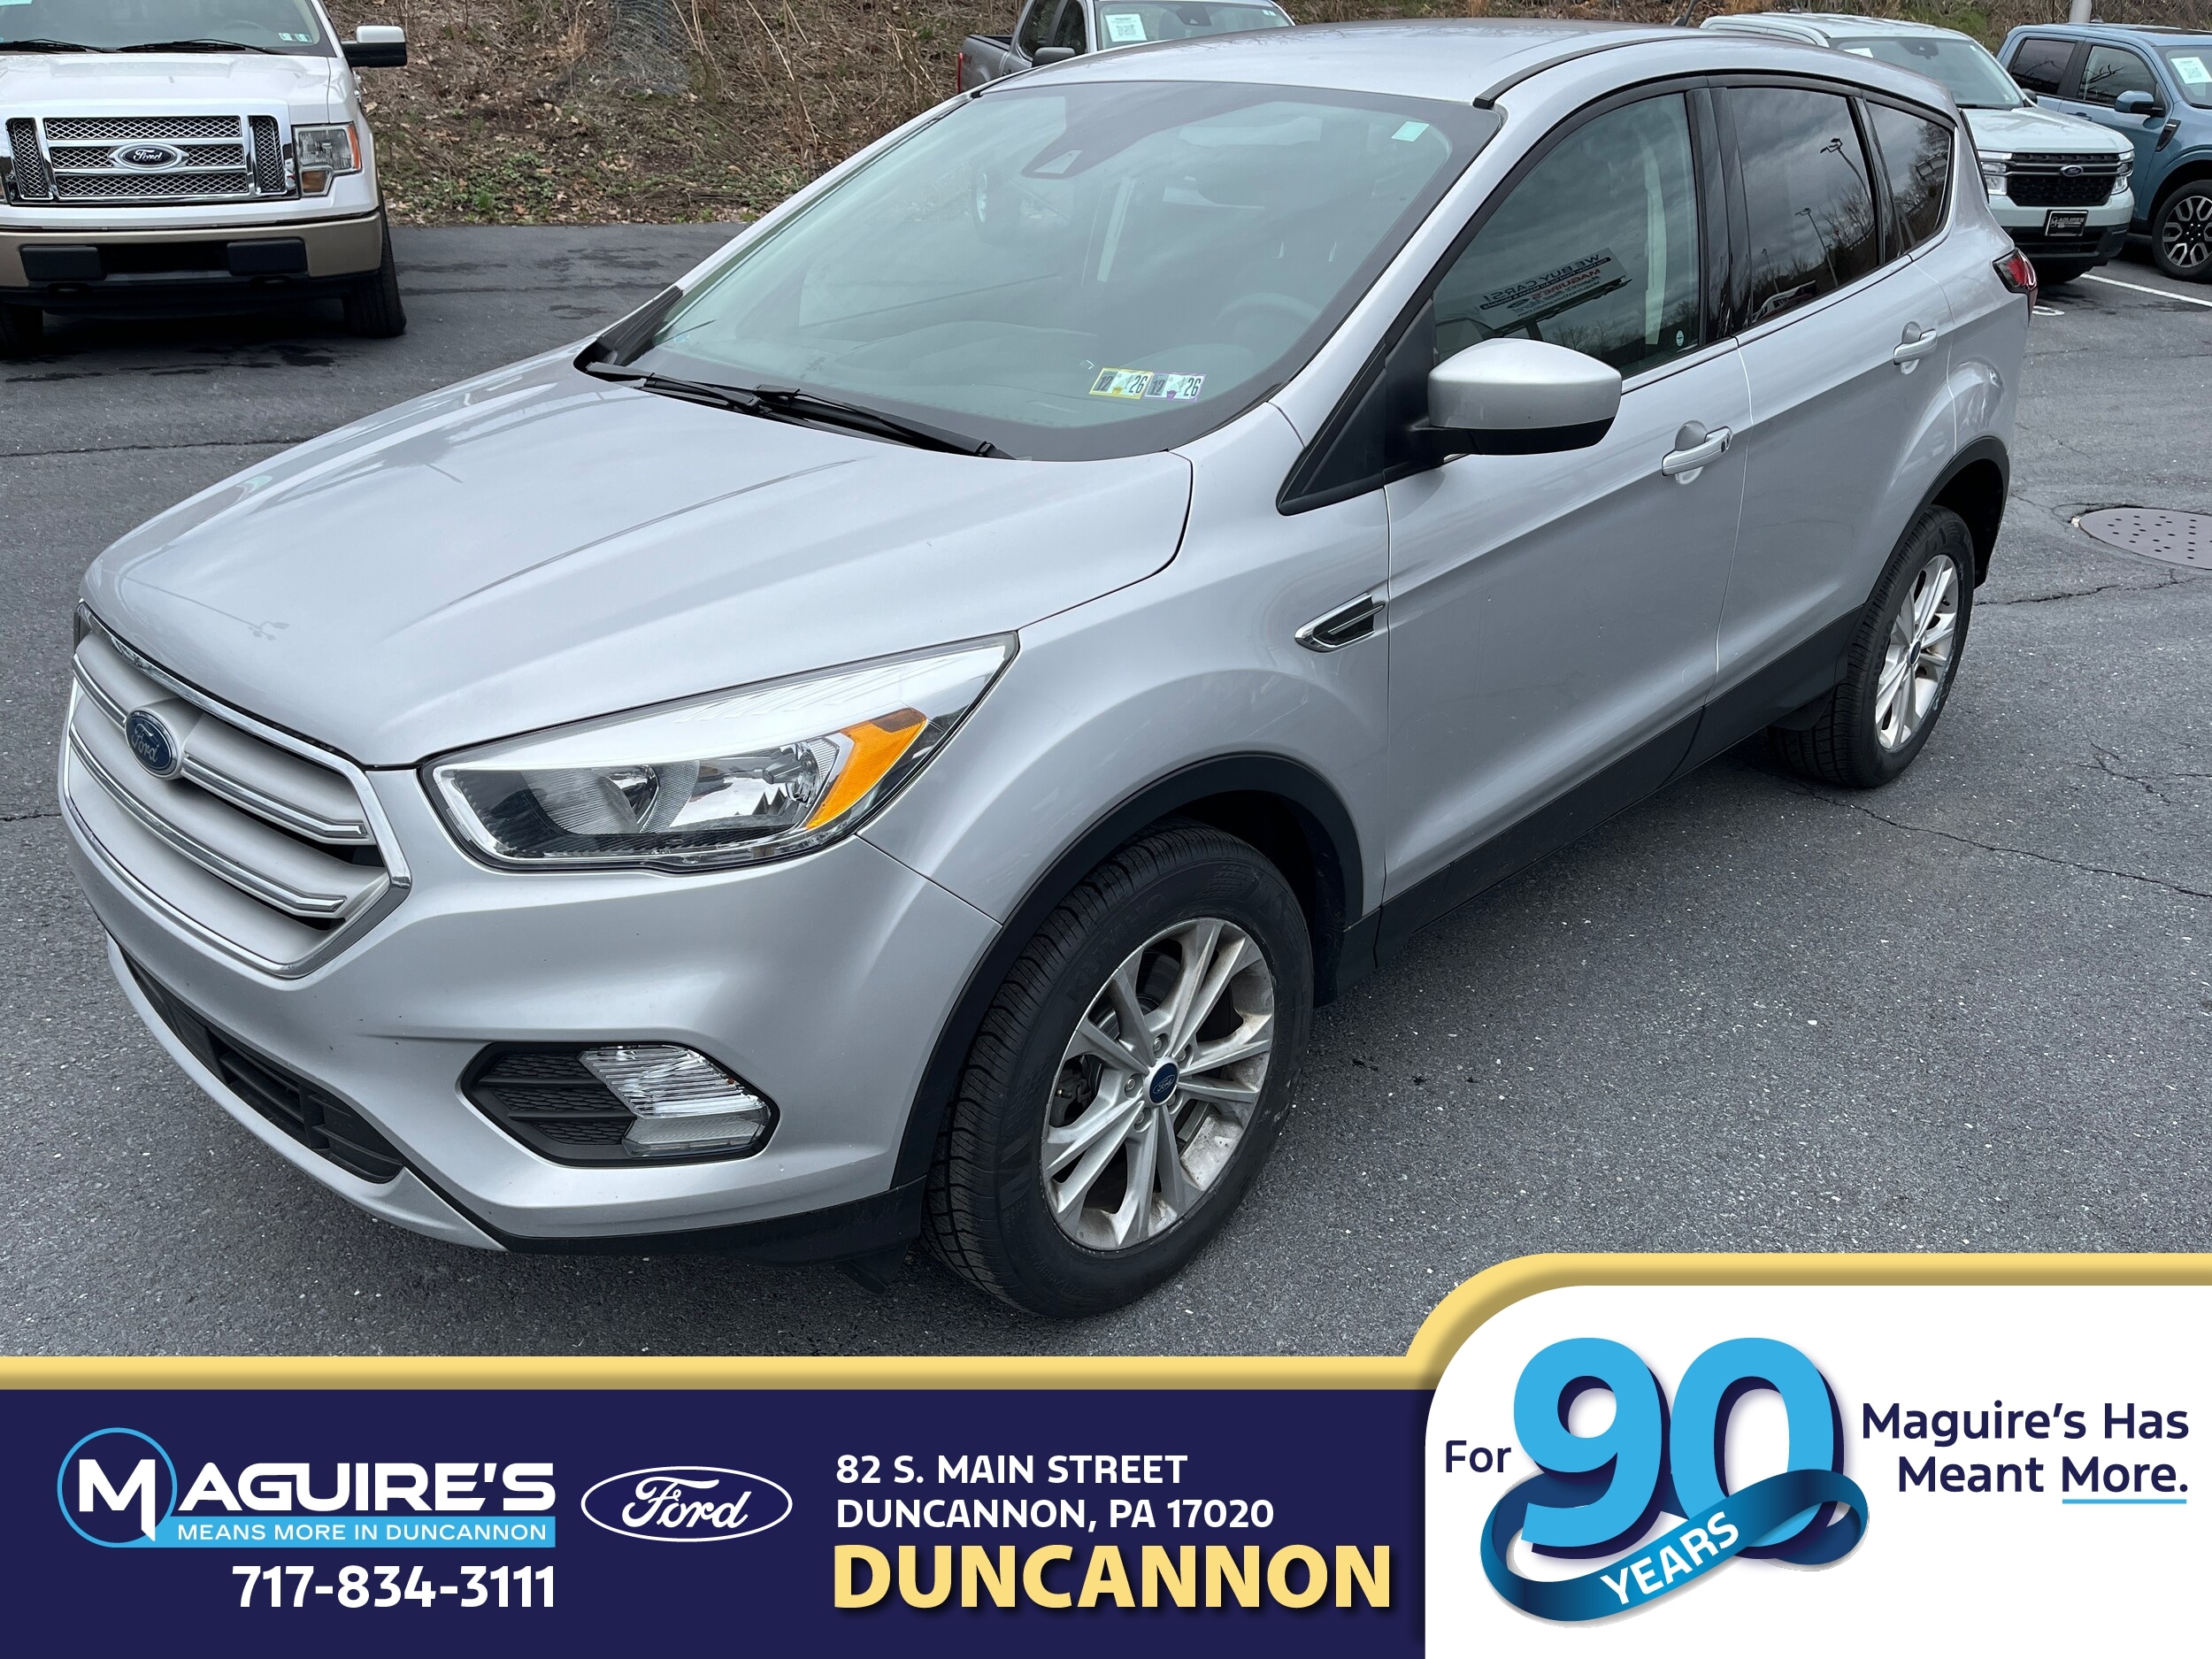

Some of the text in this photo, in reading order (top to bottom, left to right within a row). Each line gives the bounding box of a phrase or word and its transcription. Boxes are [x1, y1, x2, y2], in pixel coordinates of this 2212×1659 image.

[133, 149, 163, 161] Ford
[1096, 375, 1148, 394] 12 26
[1150, 378, 1202, 396] 12 26
[131, 723, 160, 763] Ford
